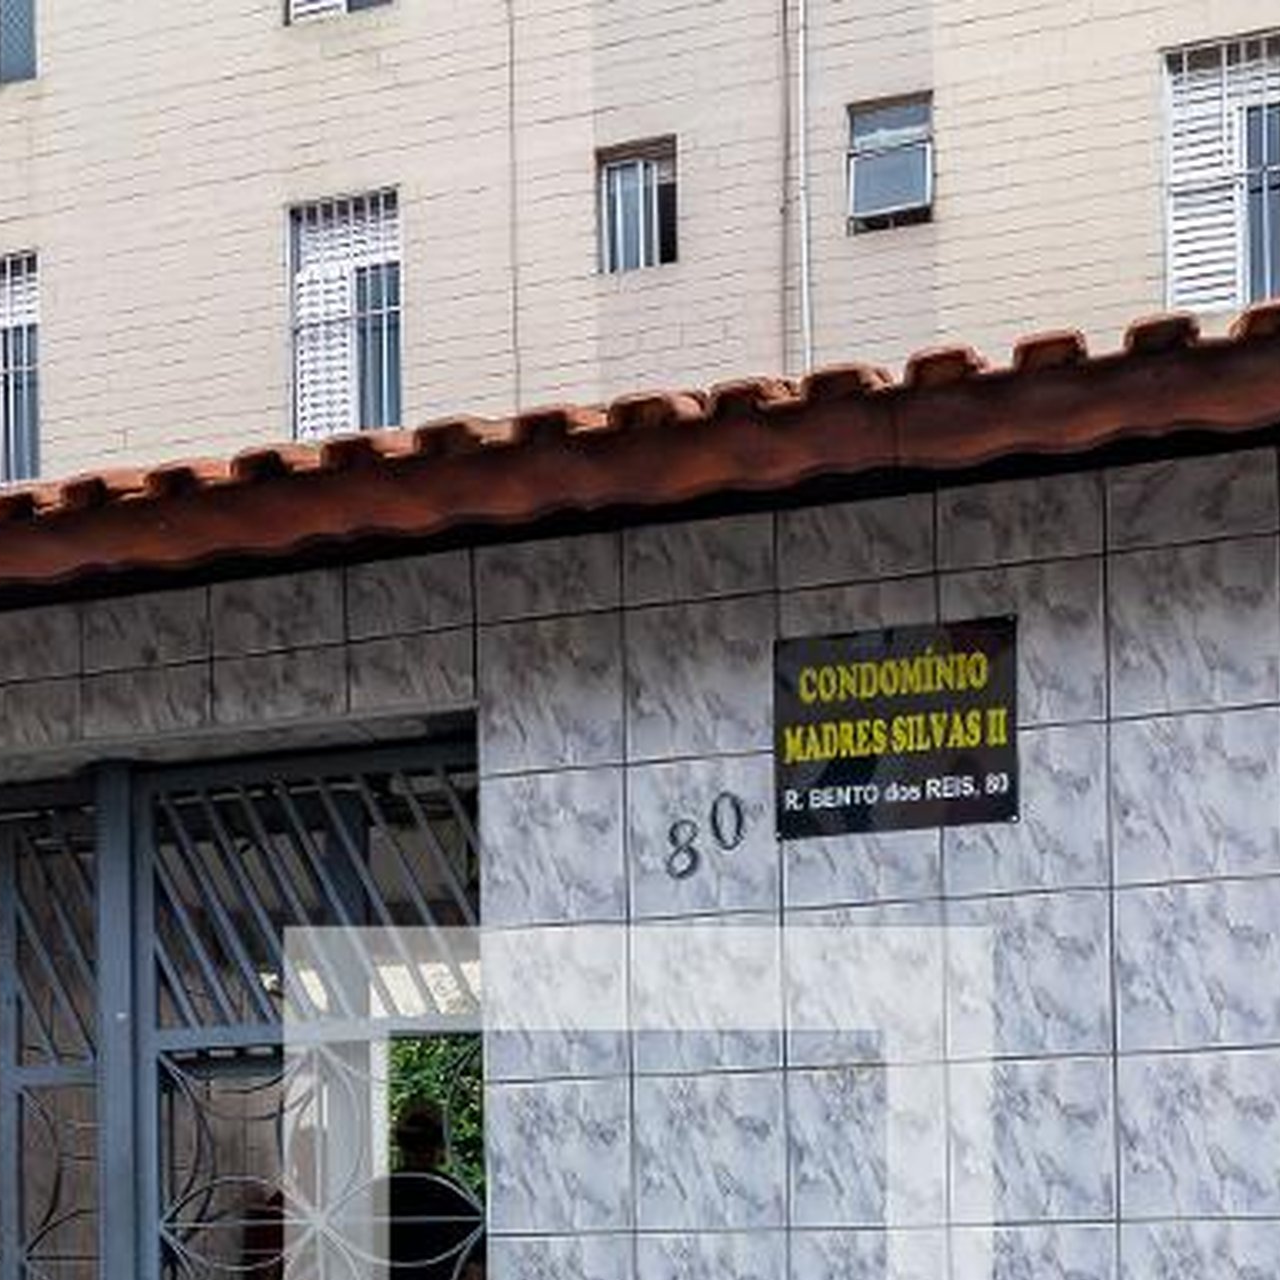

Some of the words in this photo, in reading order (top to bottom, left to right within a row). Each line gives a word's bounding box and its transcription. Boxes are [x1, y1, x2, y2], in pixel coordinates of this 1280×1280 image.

[799, 647, 988, 702] CONDOMÍNIO
[784, 718, 888, 764] MADRES
[891, 708, 981, 754] SILVAS
[986, 707, 1008, 746] II
[808, 784, 879, 809] BENTO
[883, 780, 921, 803] dos
[984, 771, 1009, 794] 80
[666, 791, 744, 879] 80
